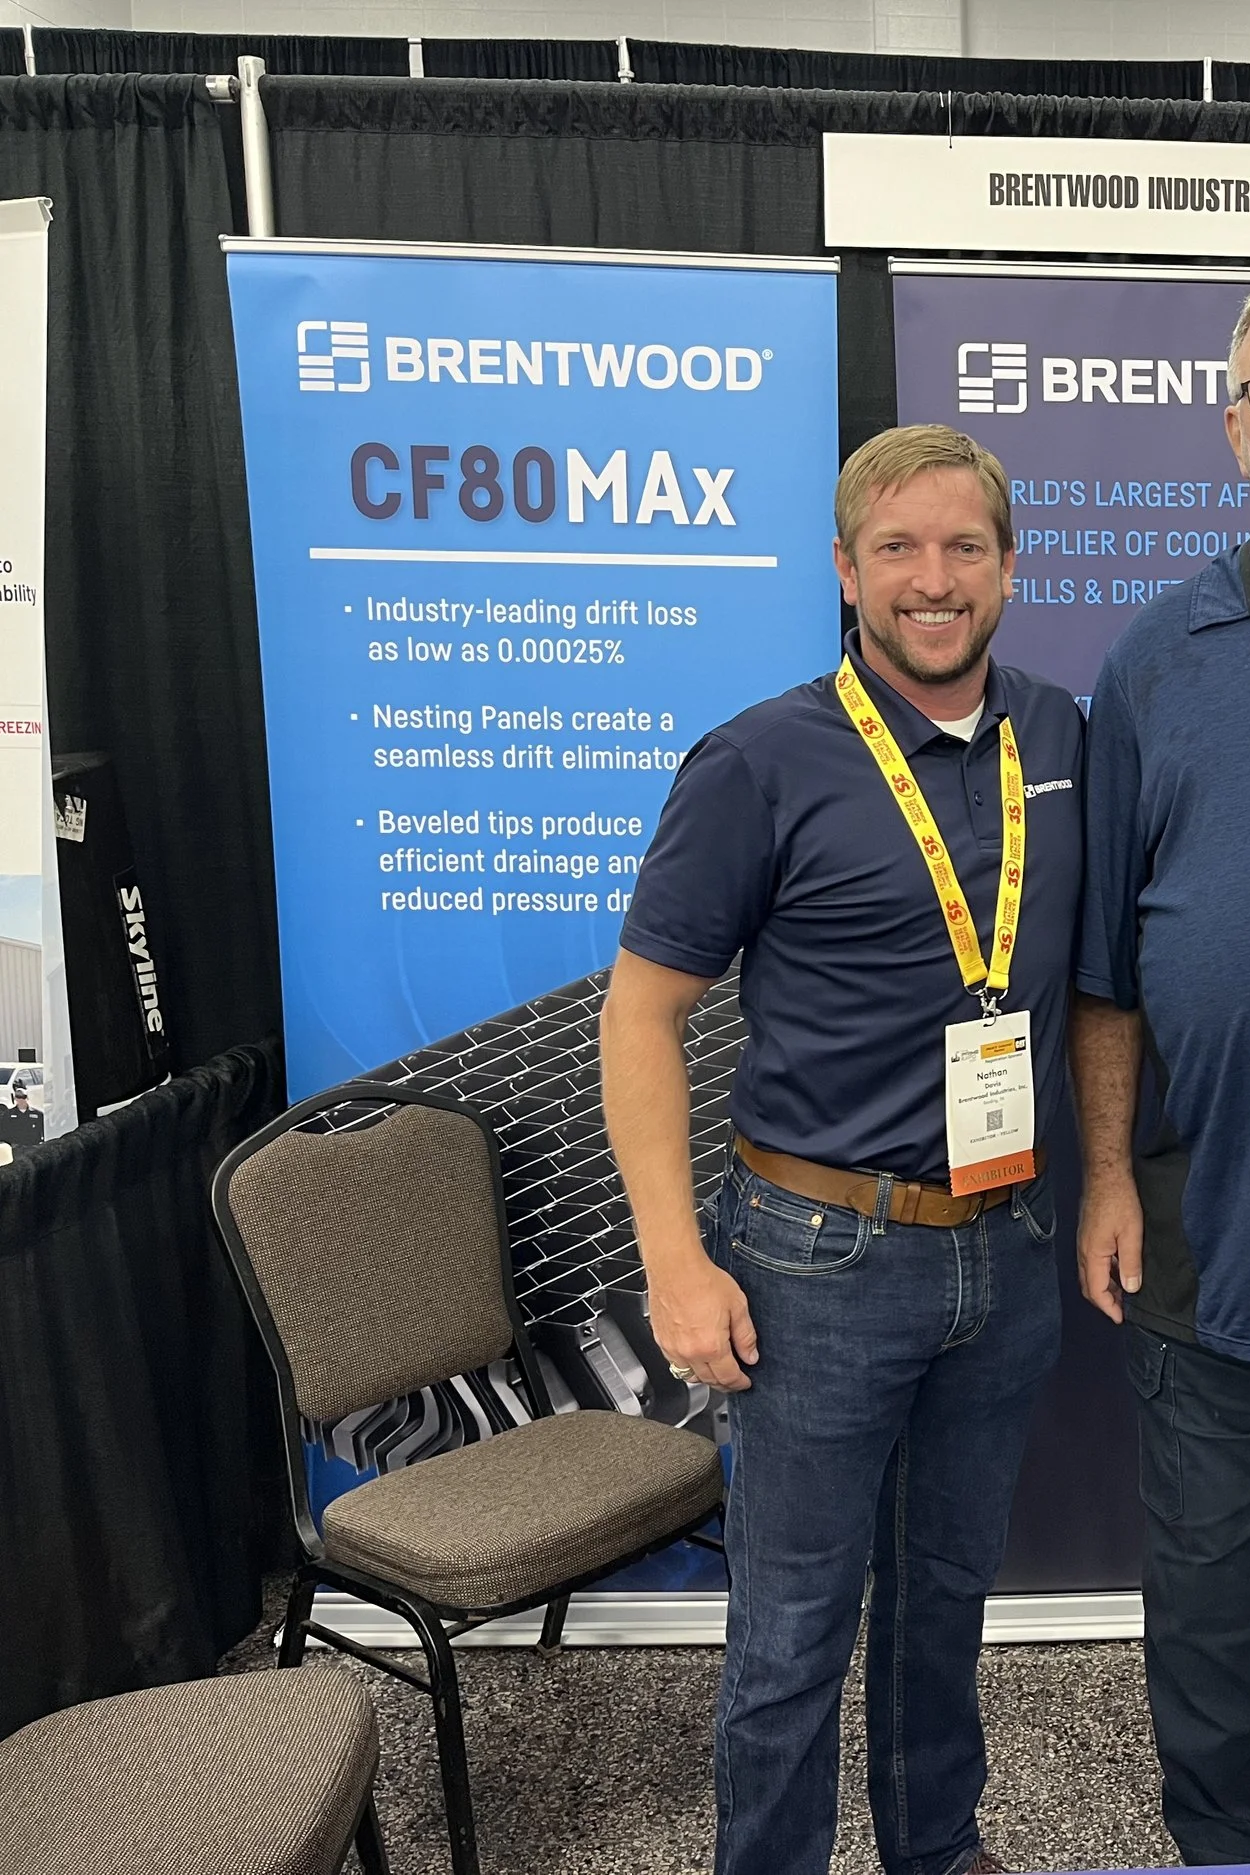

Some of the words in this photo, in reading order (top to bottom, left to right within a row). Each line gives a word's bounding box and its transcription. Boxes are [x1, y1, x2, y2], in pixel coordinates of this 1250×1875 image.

[990, 173, 1138, 208] BRENTWOOD
[1012, 480, 1085, 506] RLD’S
[1096, 482, 1211, 507] LARGEST
[1015, 530, 1116, 555] UPPLIER
[1127, 531, 1158, 555] OF
[1085, 579, 1102, 604] &
[368, 597, 576, 629] Industry-leading
[586, 600, 638, 624] drift
[648, 601, 696, 625] loss
[369, 642, 398, 660] as
[408, 637, 452, 661] low
[462, 643, 489, 662] as
[499, 638, 624, 663] 0.00025%
[374, 705, 472, 734] Nesting
[482, 706, 562, 730] Panels
[572, 708, 651, 731] create
[661, 713, 673, 731] a
[375, 744, 494, 768] seamless
[503, 745, 553, 768] drift
[379, 810, 479, 834] Beveled
[488, 811, 533, 839] tips
[543, 812, 641, 839] produce
[380, 848, 485, 872] efficient
[494, 849, 599, 879] drainage
[608, 855, 645, 874] an
[382, 887, 482, 910] reduced
[493, 893, 597, 915] pressure
[607, 888, 632, 911] dr
[120, 886, 164, 1033] Skyline
[976, 1069, 1008, 1081] Nathan
[984, 1081, 1001, 1089] Davis
[962, 1163, 1025, 1188] EXHIBITOR
